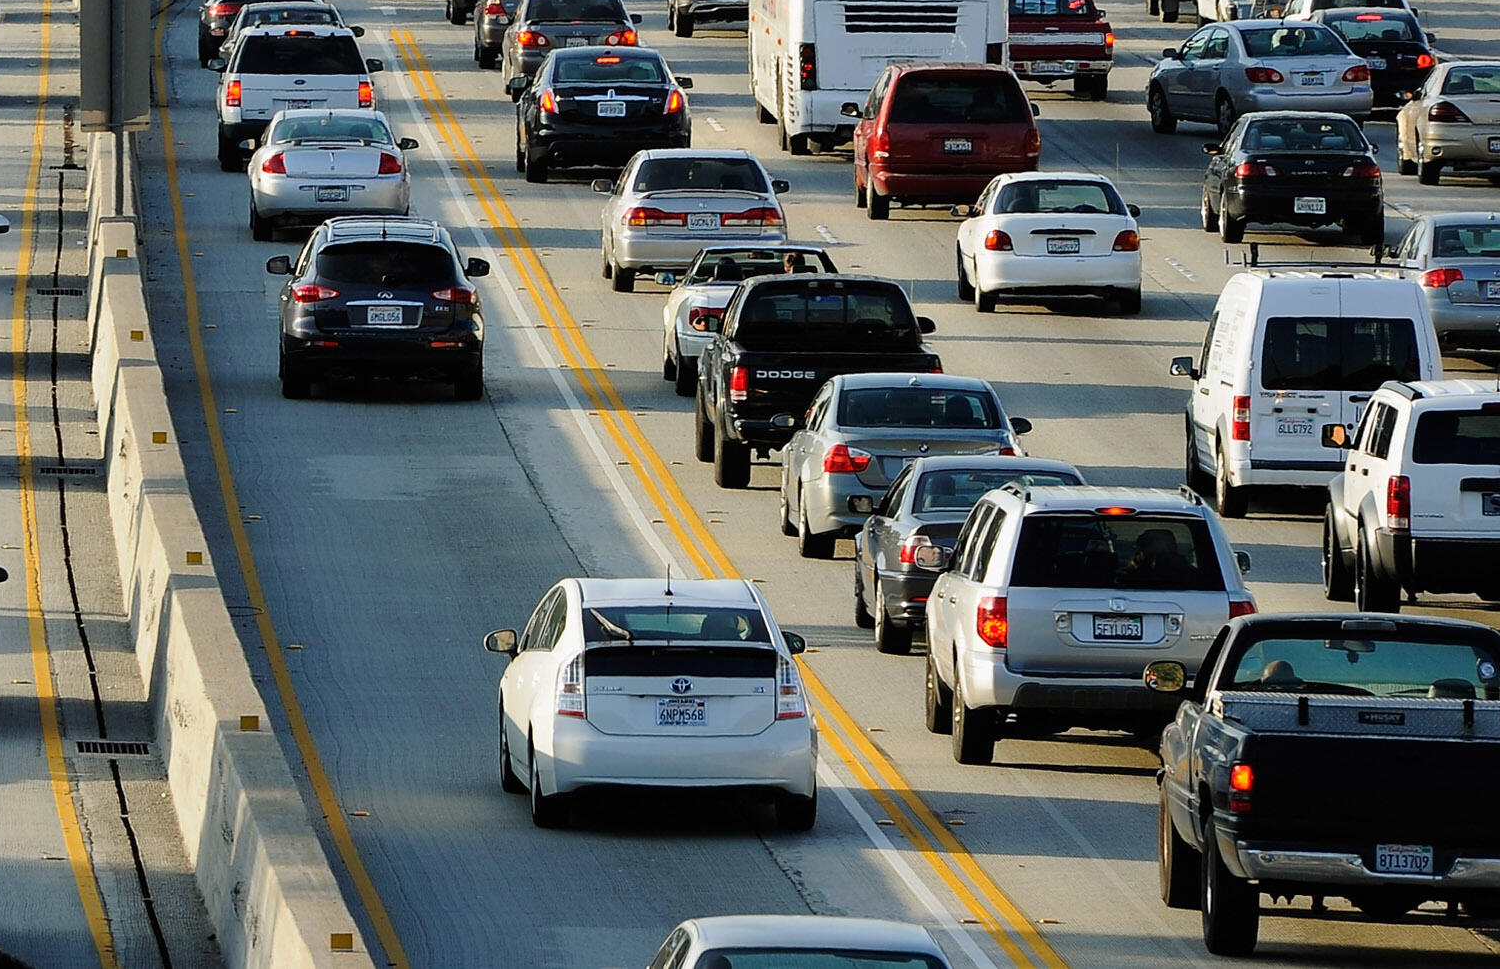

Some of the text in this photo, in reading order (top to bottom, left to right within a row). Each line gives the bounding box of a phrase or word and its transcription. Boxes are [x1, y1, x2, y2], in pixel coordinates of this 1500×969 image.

[756, 369, 816, 379] DODGE
[659, 708, 704, 721] 6NPM568
[1379, 853, 1430, 869] 8T13709
